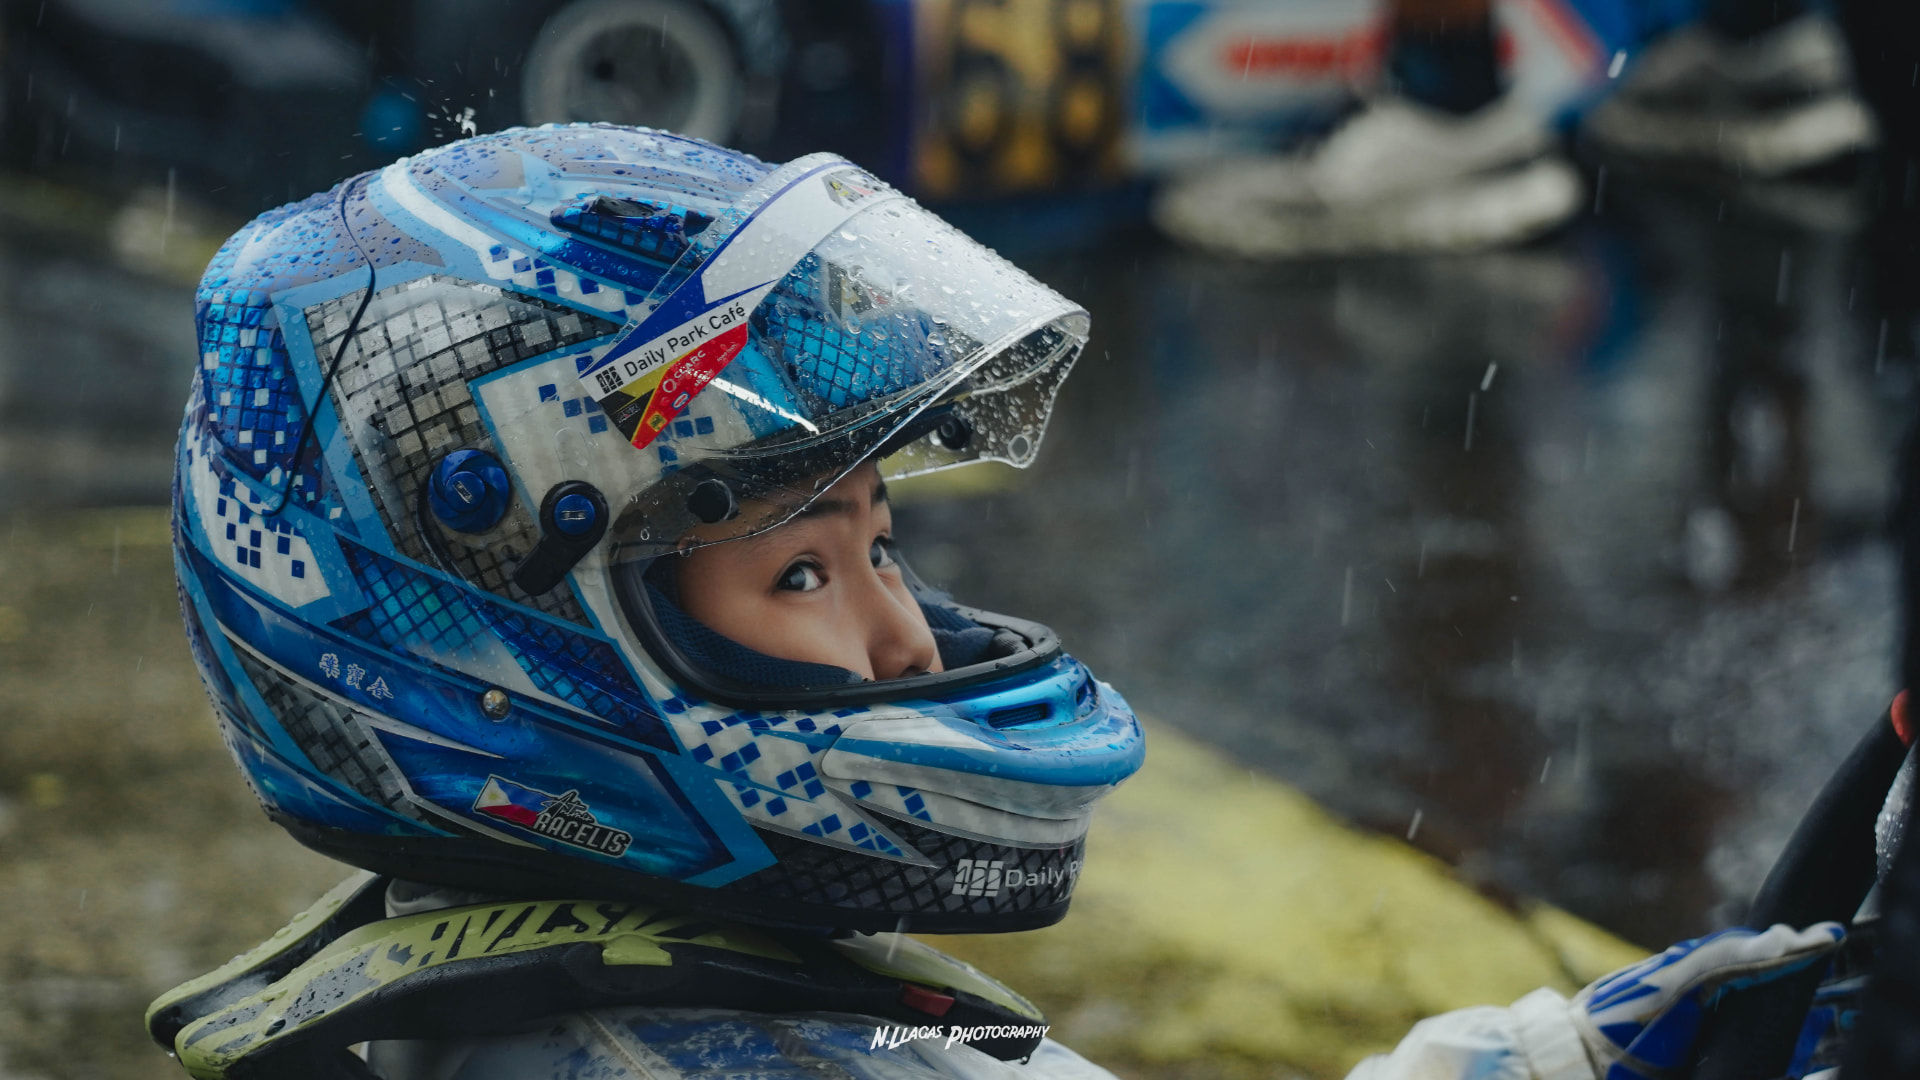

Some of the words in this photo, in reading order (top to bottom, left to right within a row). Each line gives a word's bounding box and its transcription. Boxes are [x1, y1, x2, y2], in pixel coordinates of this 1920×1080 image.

[623, 347, 665, 377] Daily
[667, 325, 708, 352] Park
[708, 302, 746, 330] Café
[533, 812, 627, 853] RACELIS
[1005, 866, 1064, 888] Daily
